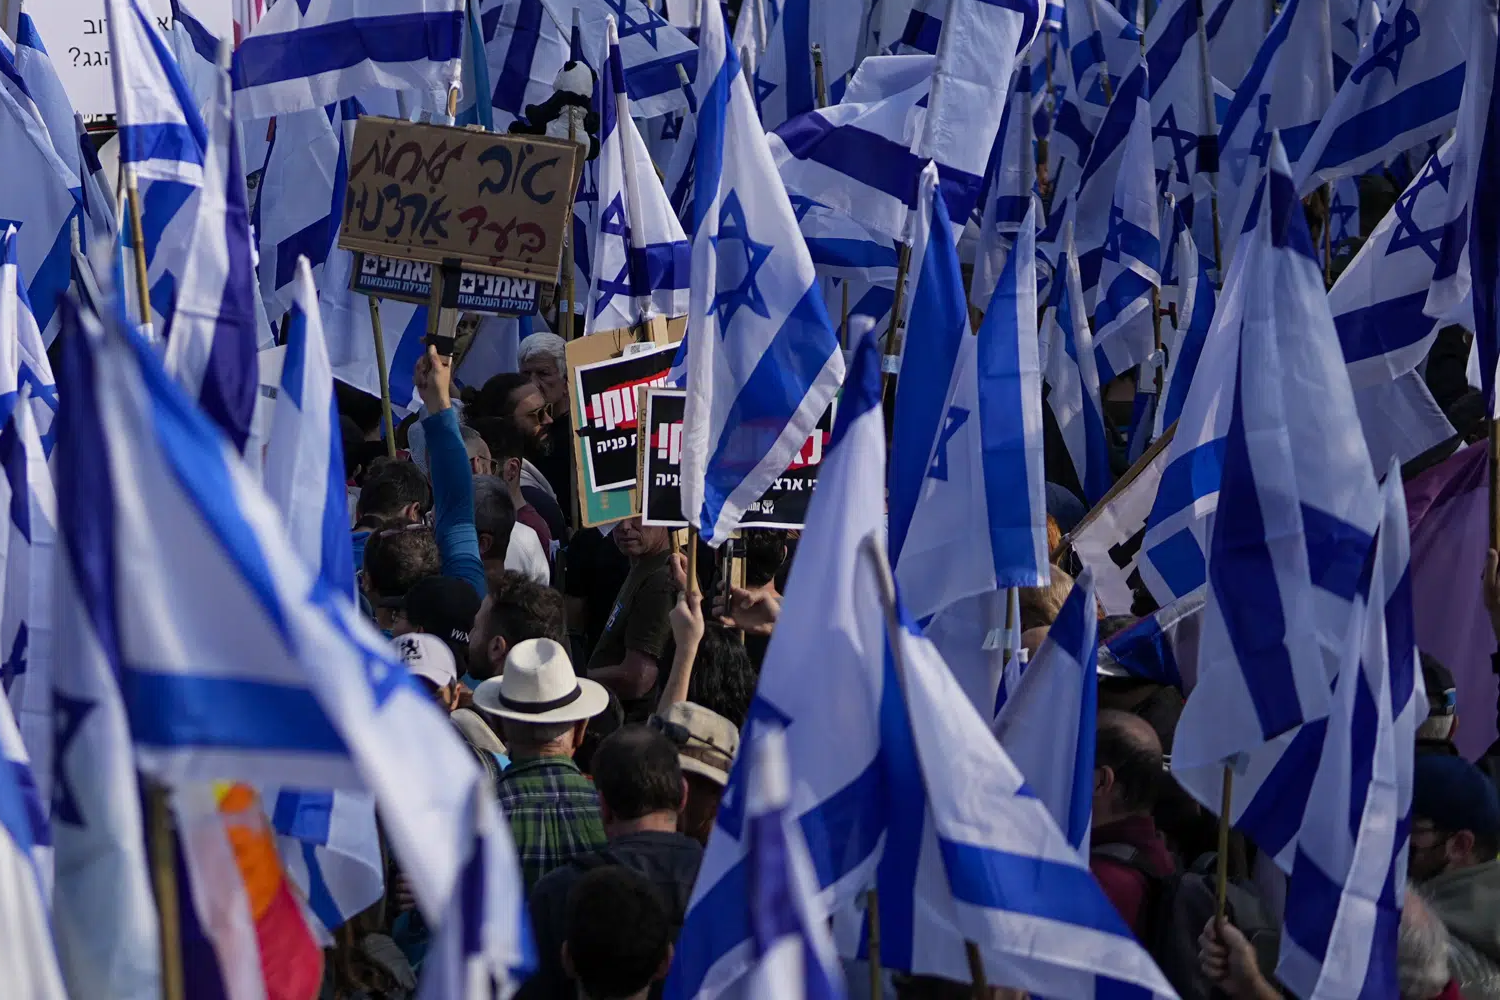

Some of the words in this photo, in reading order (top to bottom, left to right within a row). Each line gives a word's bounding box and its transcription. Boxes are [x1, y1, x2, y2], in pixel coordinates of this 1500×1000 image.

[459, 272, 536, 300] נאמנים
[457, 294, 500, 307] העצמאות
[502, 298, 534, 311] למגילת
[773, 478, 803, 491] ארצ
